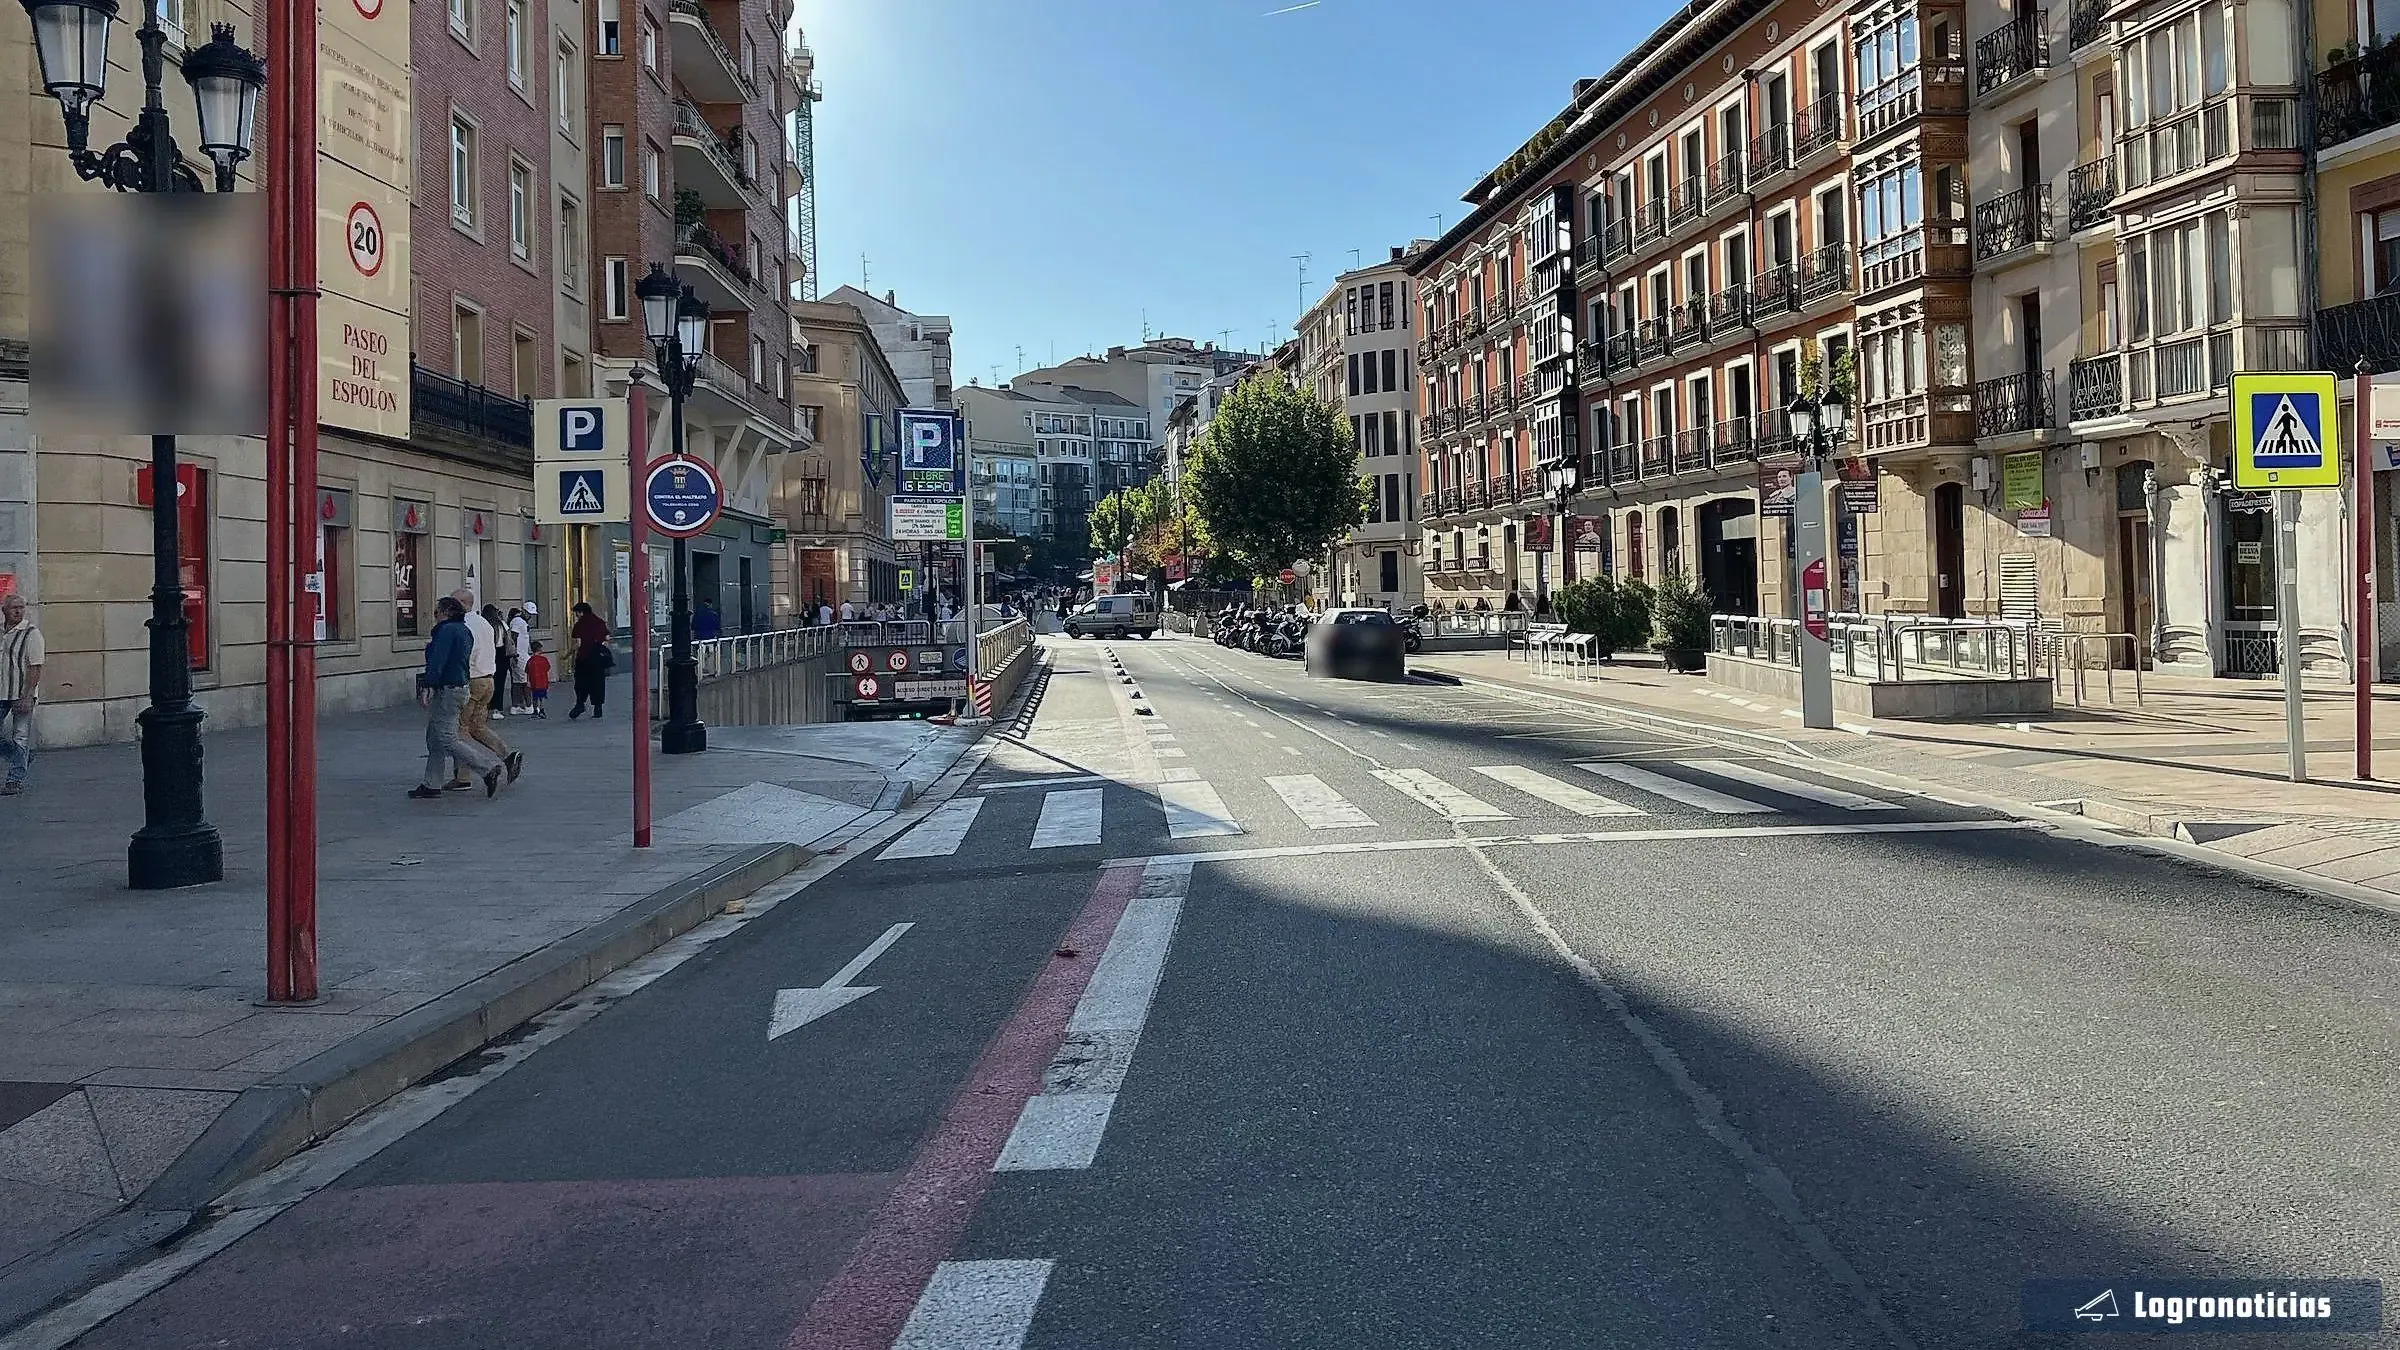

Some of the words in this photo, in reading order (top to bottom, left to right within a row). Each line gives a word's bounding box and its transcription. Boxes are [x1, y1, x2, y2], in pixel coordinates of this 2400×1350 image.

[354, 221, 377, 255] 20
[344, 324, 387, 355] PASEO
[352, 355, 380, 381] DEL
[332, 379, 397, 412] ESPOLON
[567, 411, 595, 448] P
[913, 422, 941, 463] P
[913, 471, 945, 480] LIBRE
[893, 657, 905, 665] 10
